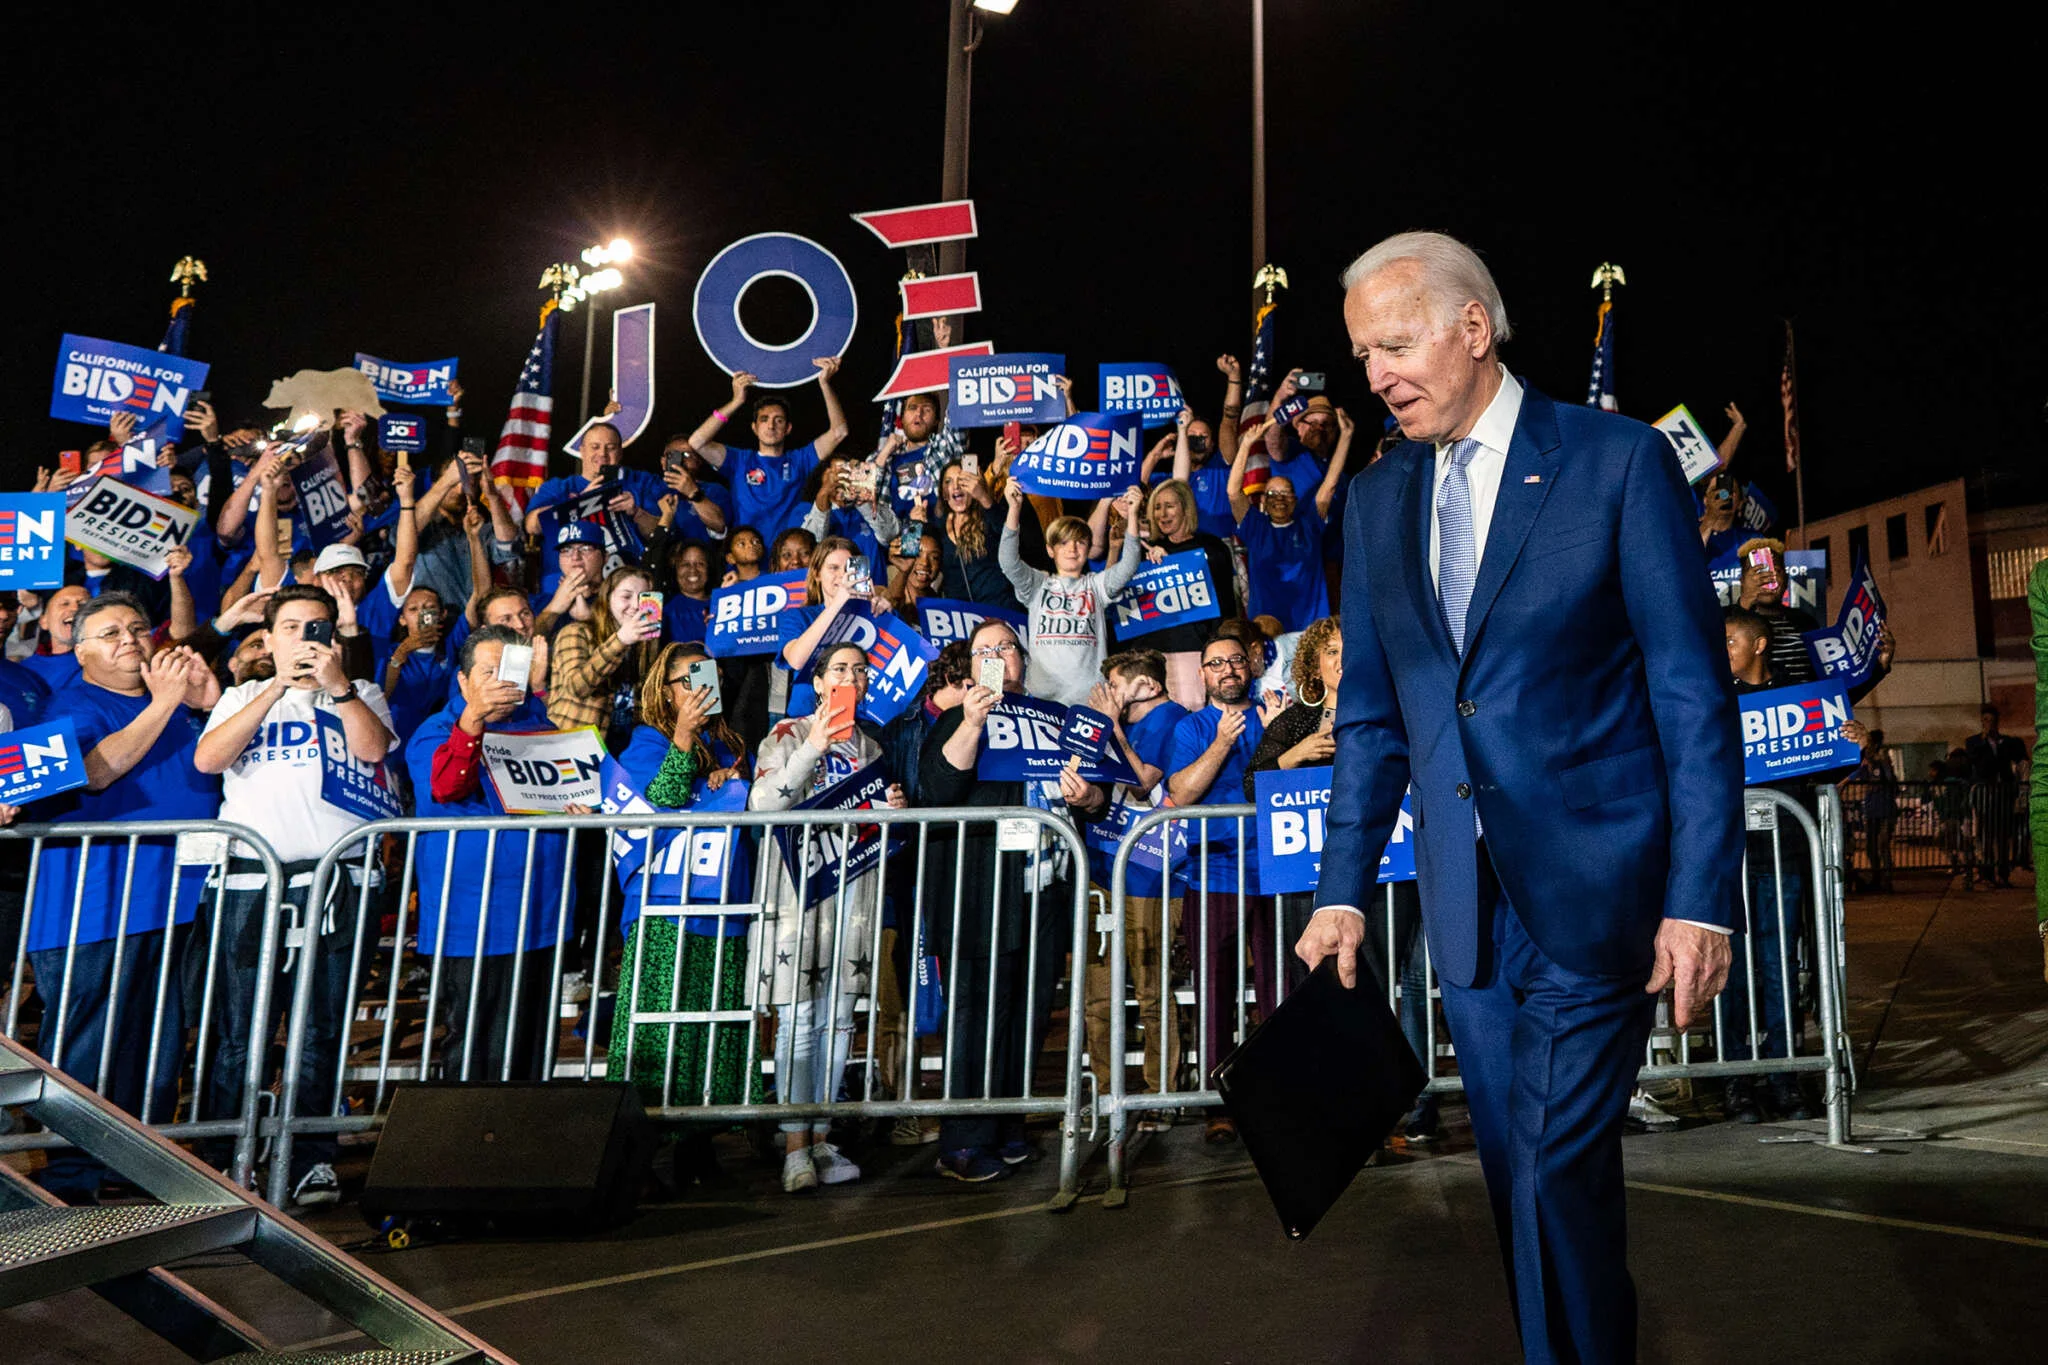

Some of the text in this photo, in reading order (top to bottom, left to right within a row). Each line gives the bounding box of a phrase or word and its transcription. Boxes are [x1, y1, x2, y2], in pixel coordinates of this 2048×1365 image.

[563, 199, 994, 450] JOE
[68, 350, 184, 384] CALIFORNIA FOR
[360, 360, 451, 385] BIDEN
[957, 363, 1049, 378] CALIFORNIA FOR
[62, 363, 189, 417] BIDEN
[368, 376, 449, 392] RESIDENT
[957, 374, 1058, 406] BIDEN
[1105, 374, 1184, 399] BIDEN
[996, 408, 1006, 416] CA
[386, 425, 417, 436] JOE
[1025, 424, 1137, 460] BIDEN
[1017, 453, 1136, 476] PRESIDENT
[1036, 476, 1052, 486] Text
[1052, 478, 1080, 488] UNITED
[304, 479, 348, 527] BID
[83, 488, 189, 547] BIDEN
[73, 511, 172, 557] PRESIDENT
[1122, 569, 1205, 599] PRESIDEN
[1711, 568, 1742, 579] CALIF
[715, 582, 808, 624] BIDE
[1116, 581, 1212, 628] BIDEN
[1713, 578, 1817, 609] BIN
[713, 615, 777, 636] PRESI
[1037, 614, 1097, 636] BIDEN
[1813, 563, 1877, 664] BIDEN
[1823, 611, 1882, 676] PRESIDE
[1070, 721, 1102, 742] JOE
[1740, 694, 1849, 745] BIDEN
[245, 720, 319, 752] BID
[1744, 728, 1840, 758] PRESIDEN
[241, 747, 320, 766] PRESID
[484, 744, 512, 756] Pride
[1026, 757, 1047, 767] Text
[1049, 756, 1060, 767] CA
[1765, 758, 1782, 768] Text
[1782, 754, 1802, 765] JOIN
[1801, 752, 1811, 761] to
[504, 753, 601, 786] BIDEN
[860, 777, 885, 800] FOR
[1270, 788, 1332, 808] CALIFO
[846, 857, 858, 868] CA
[864, 840, 882, 857] 3033
[1147, 844, 1172, 859] 303
